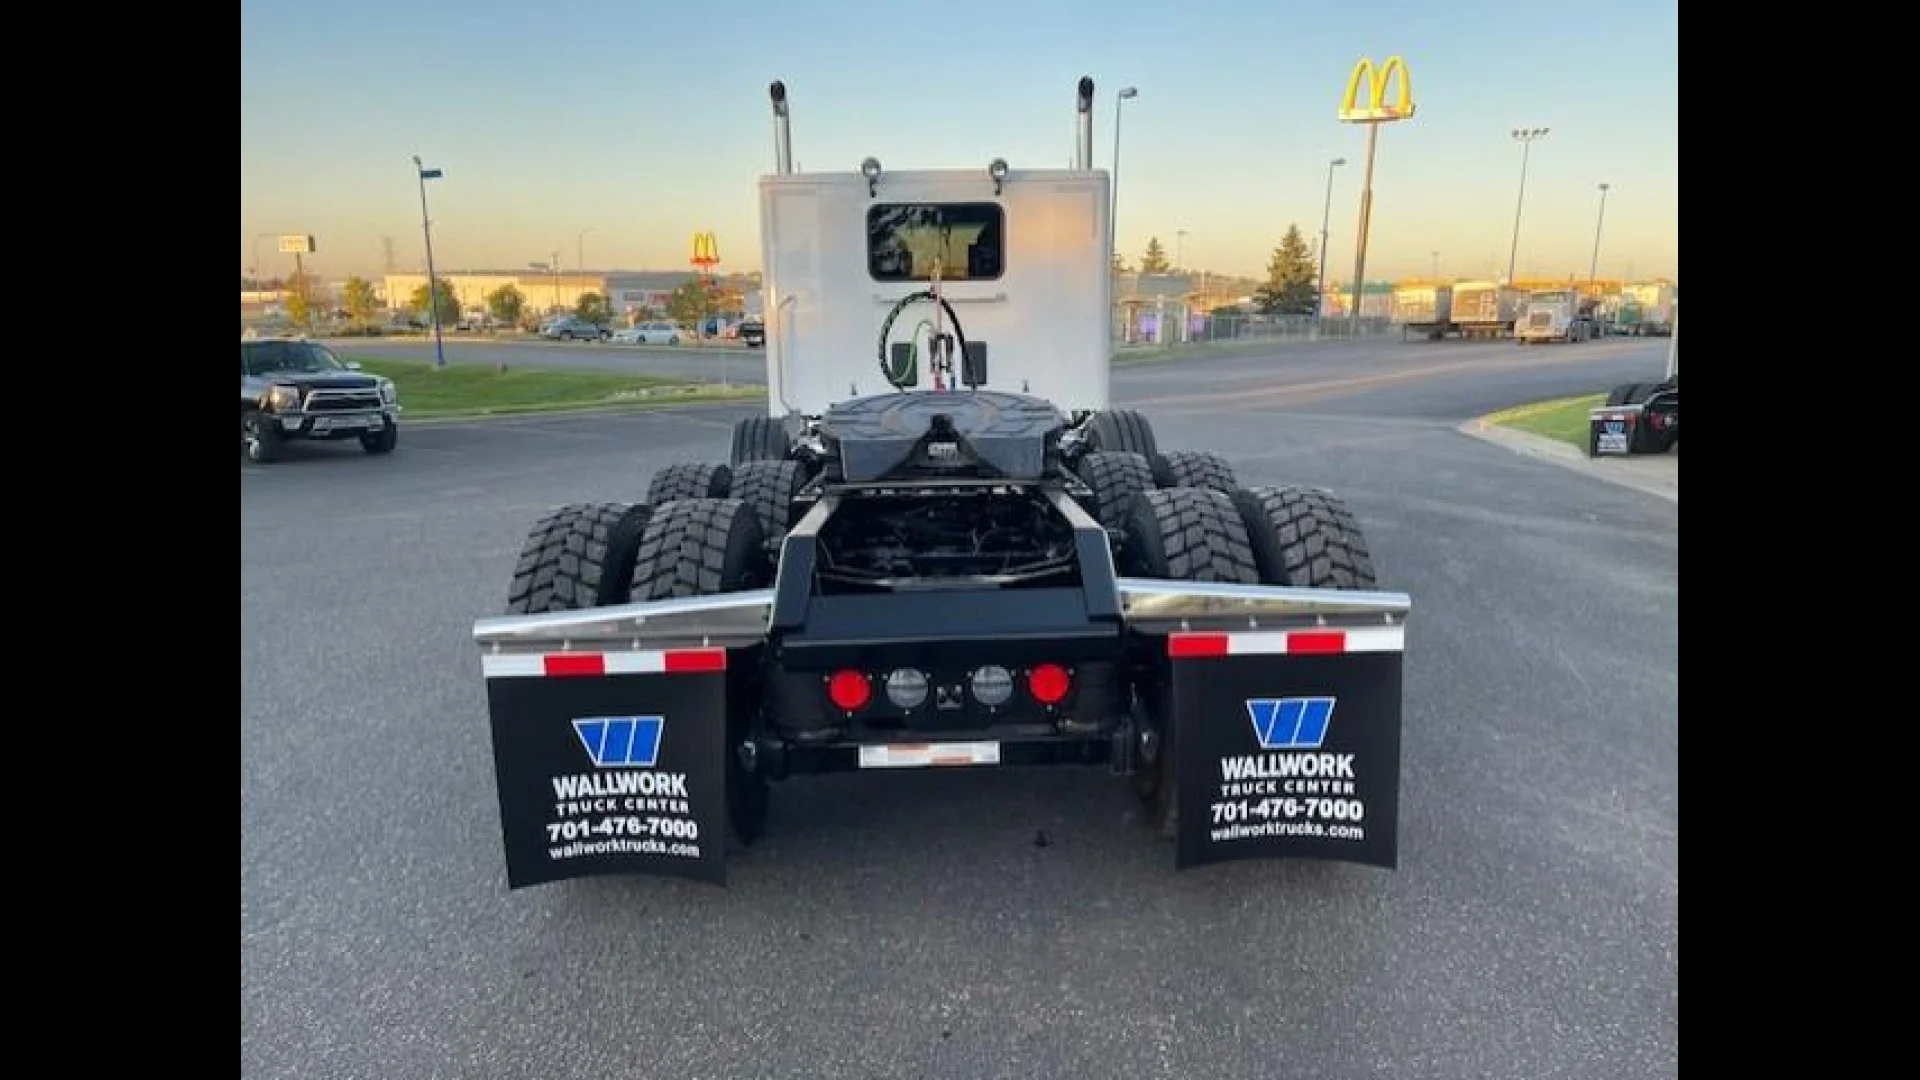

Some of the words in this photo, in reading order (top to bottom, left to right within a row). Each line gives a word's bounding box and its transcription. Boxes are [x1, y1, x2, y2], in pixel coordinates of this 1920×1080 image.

[1221, 753, 1355, 782] WALLWORK
[552, 772, 688, 800] WALLWORK
[1220, 780, 1277, 797] TRUCK
[1284, 780, 1356, 795] CENTER
[555, 798, 617, 817] TRUCK
[624, 798, 689, 814] CENTER
[1211, 797, 1365, 824] 701-476-7000
[546, 816, 698, 843] 701-476-7000
[1211, 821, 1364, 842] wallworktrucks.com
[549, 837, 700, 860] wallworktrucks.com
